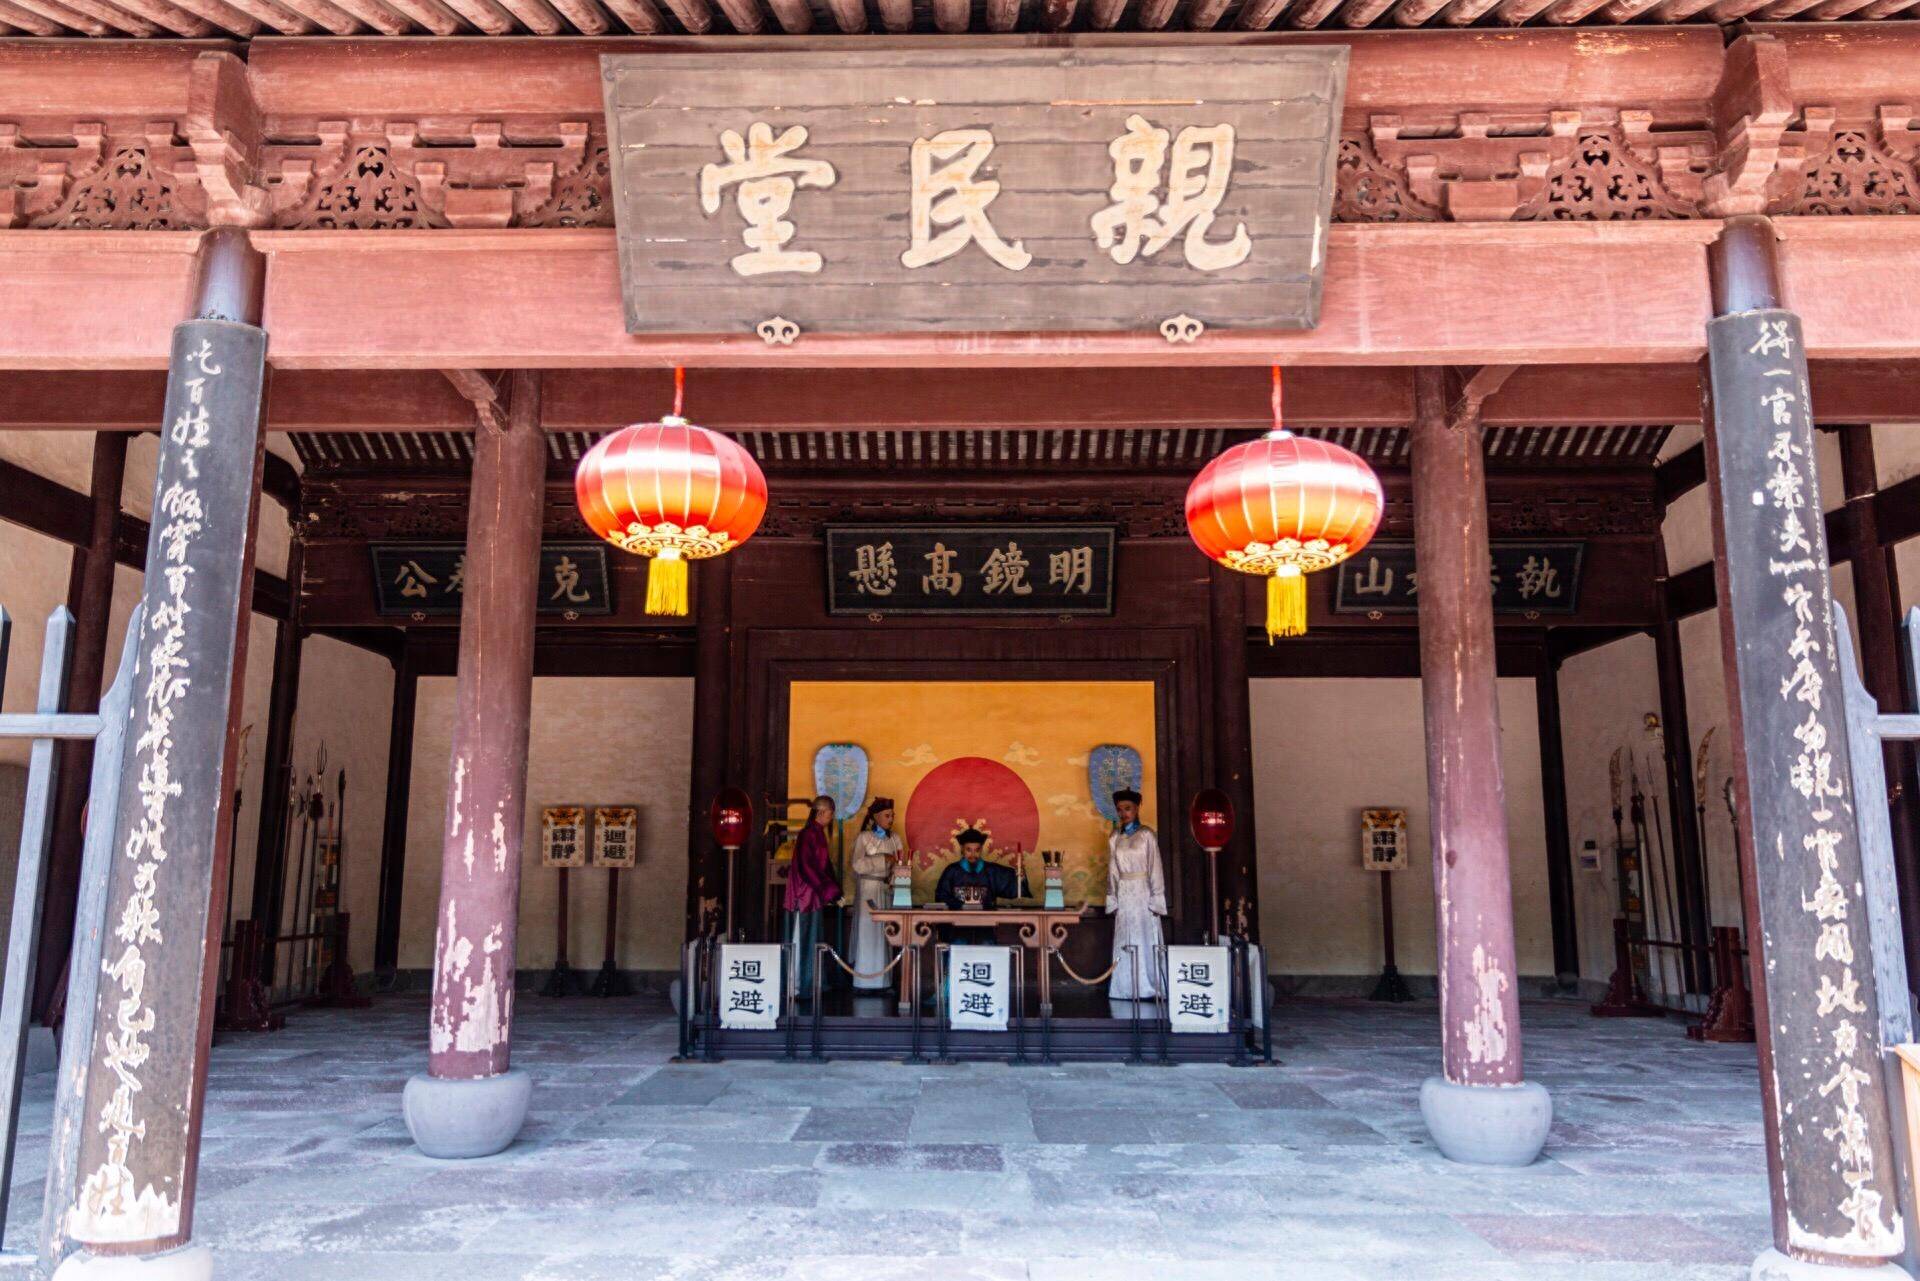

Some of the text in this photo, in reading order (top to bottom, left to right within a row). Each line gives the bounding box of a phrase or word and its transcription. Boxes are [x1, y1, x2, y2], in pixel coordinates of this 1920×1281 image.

[729, 960, 765, 1014] 迴避
[959, 962, 995, 1017] 迴避
[1177, 962, 1214, 1018] 迴避
